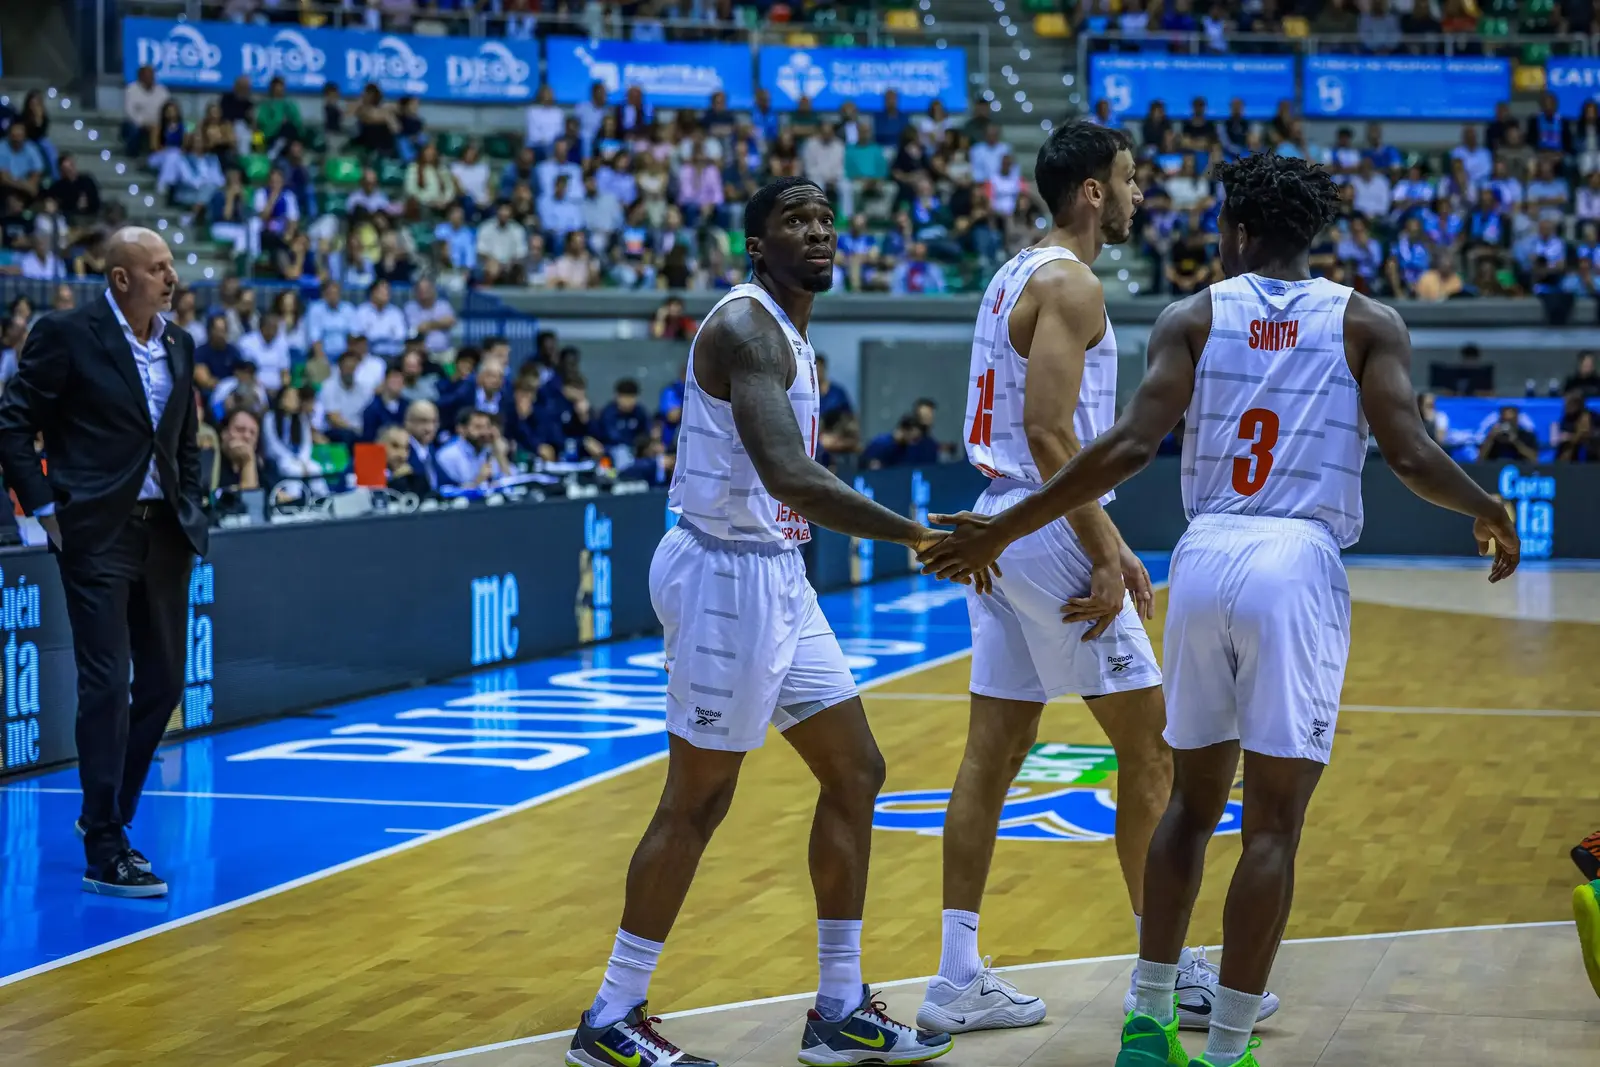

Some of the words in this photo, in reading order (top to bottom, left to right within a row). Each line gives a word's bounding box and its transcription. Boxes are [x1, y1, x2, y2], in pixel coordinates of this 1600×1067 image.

[1248, 319, 1299, 351] SMITH
[1231, 407, 1280, 497] 3
[471, 571, 519, 666] me
[5, 631, 39, 717] ta
[1107, 654, 1134, 663] Reebok
[695, 706, 722, 718] Reebok
[6, 718, 39, 769] me
